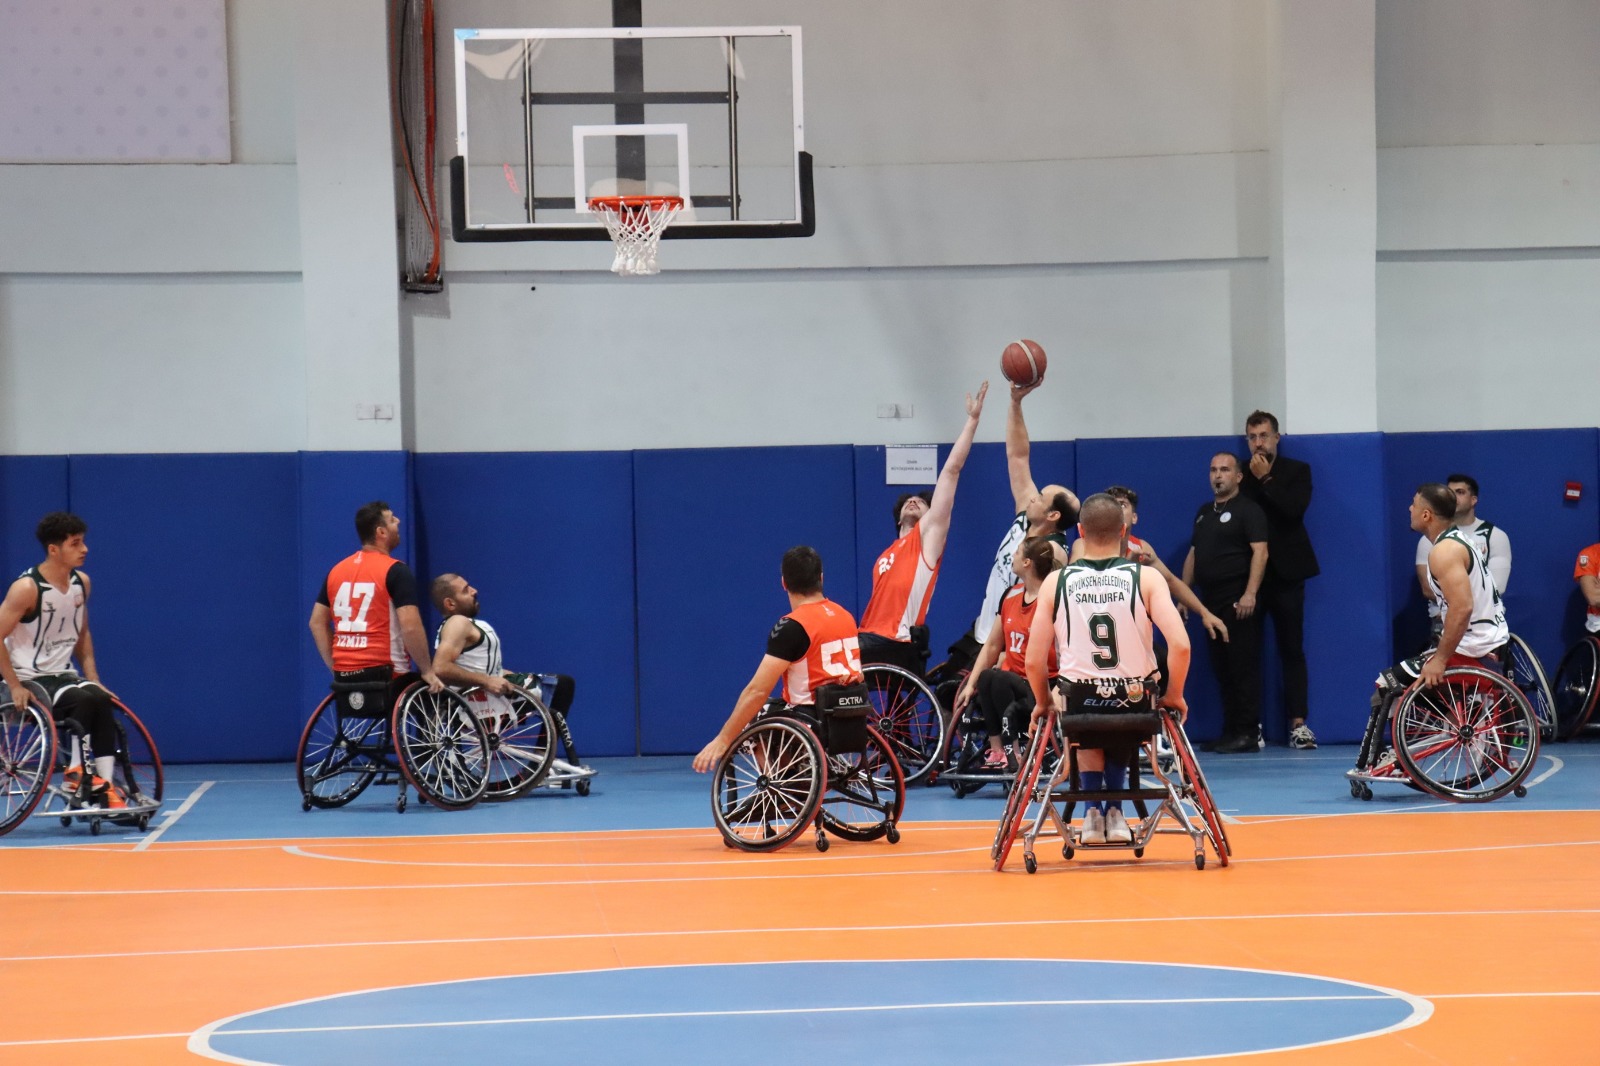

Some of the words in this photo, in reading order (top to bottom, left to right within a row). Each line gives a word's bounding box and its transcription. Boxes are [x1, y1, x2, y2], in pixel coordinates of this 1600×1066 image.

[333, 582, 376, 632] 47
[1075, 591, 1125, 604] ŞANLIURFA
[336, 633, 368, 649] İZMİR
[1009, 631, 1025, 654] 17
[1088, 612, 1121, 670] 9
[821, 636, 863, 677] 55
[839, 696, 863, 706] EXTRA
[1083, 698, 1130, 708] ELITEX
[474, 708, 496, 717] XTRA
[556, 711, 573, 748] EXTRA
